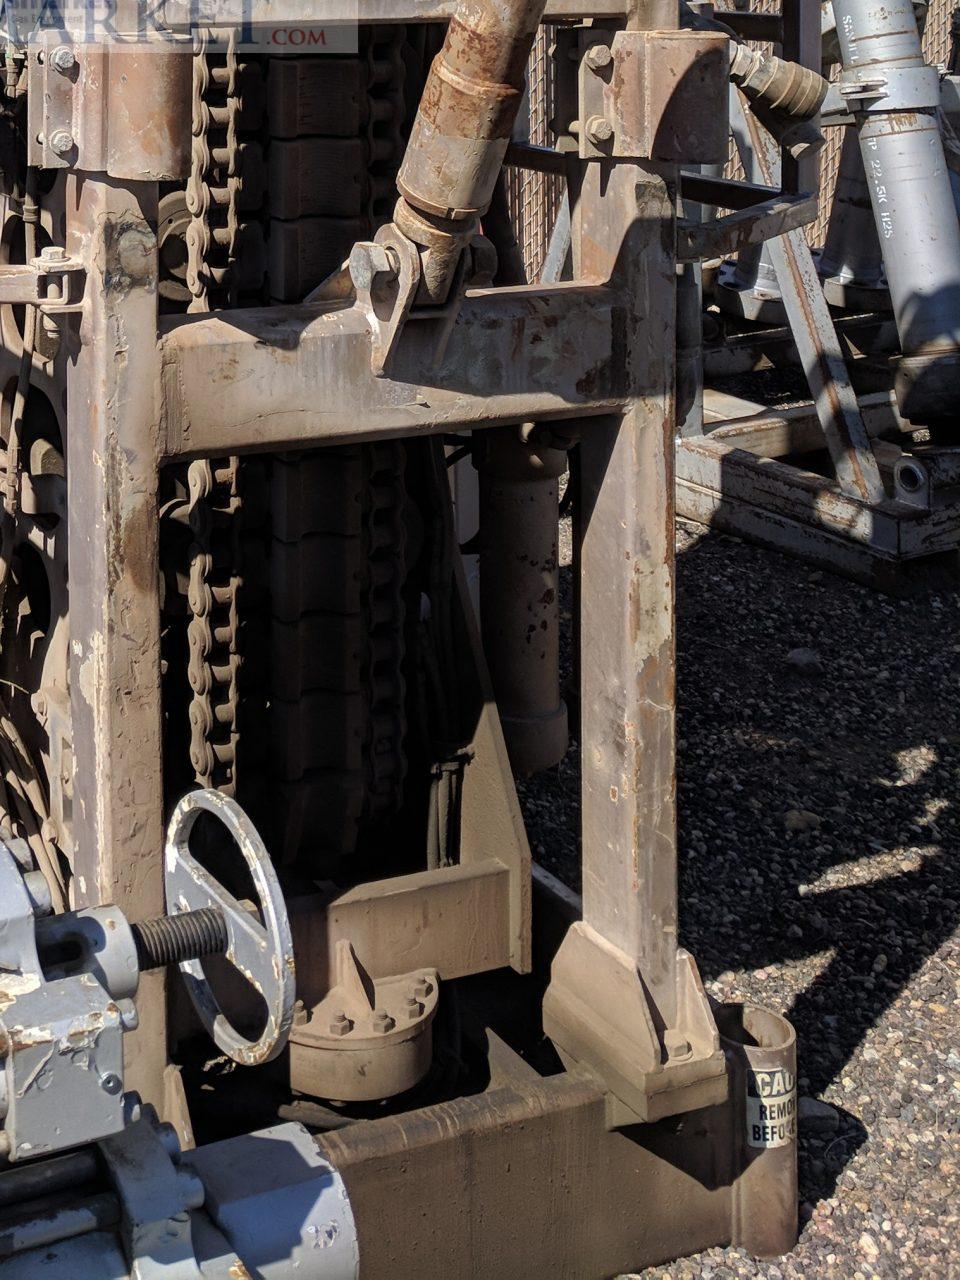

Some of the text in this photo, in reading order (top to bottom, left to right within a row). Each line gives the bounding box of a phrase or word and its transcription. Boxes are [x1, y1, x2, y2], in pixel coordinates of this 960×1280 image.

[881, 212, 893, 239] H2S
[756, 1071, 796, 1096] CAU
[752, 1118, 796, 1142] BEFOE
